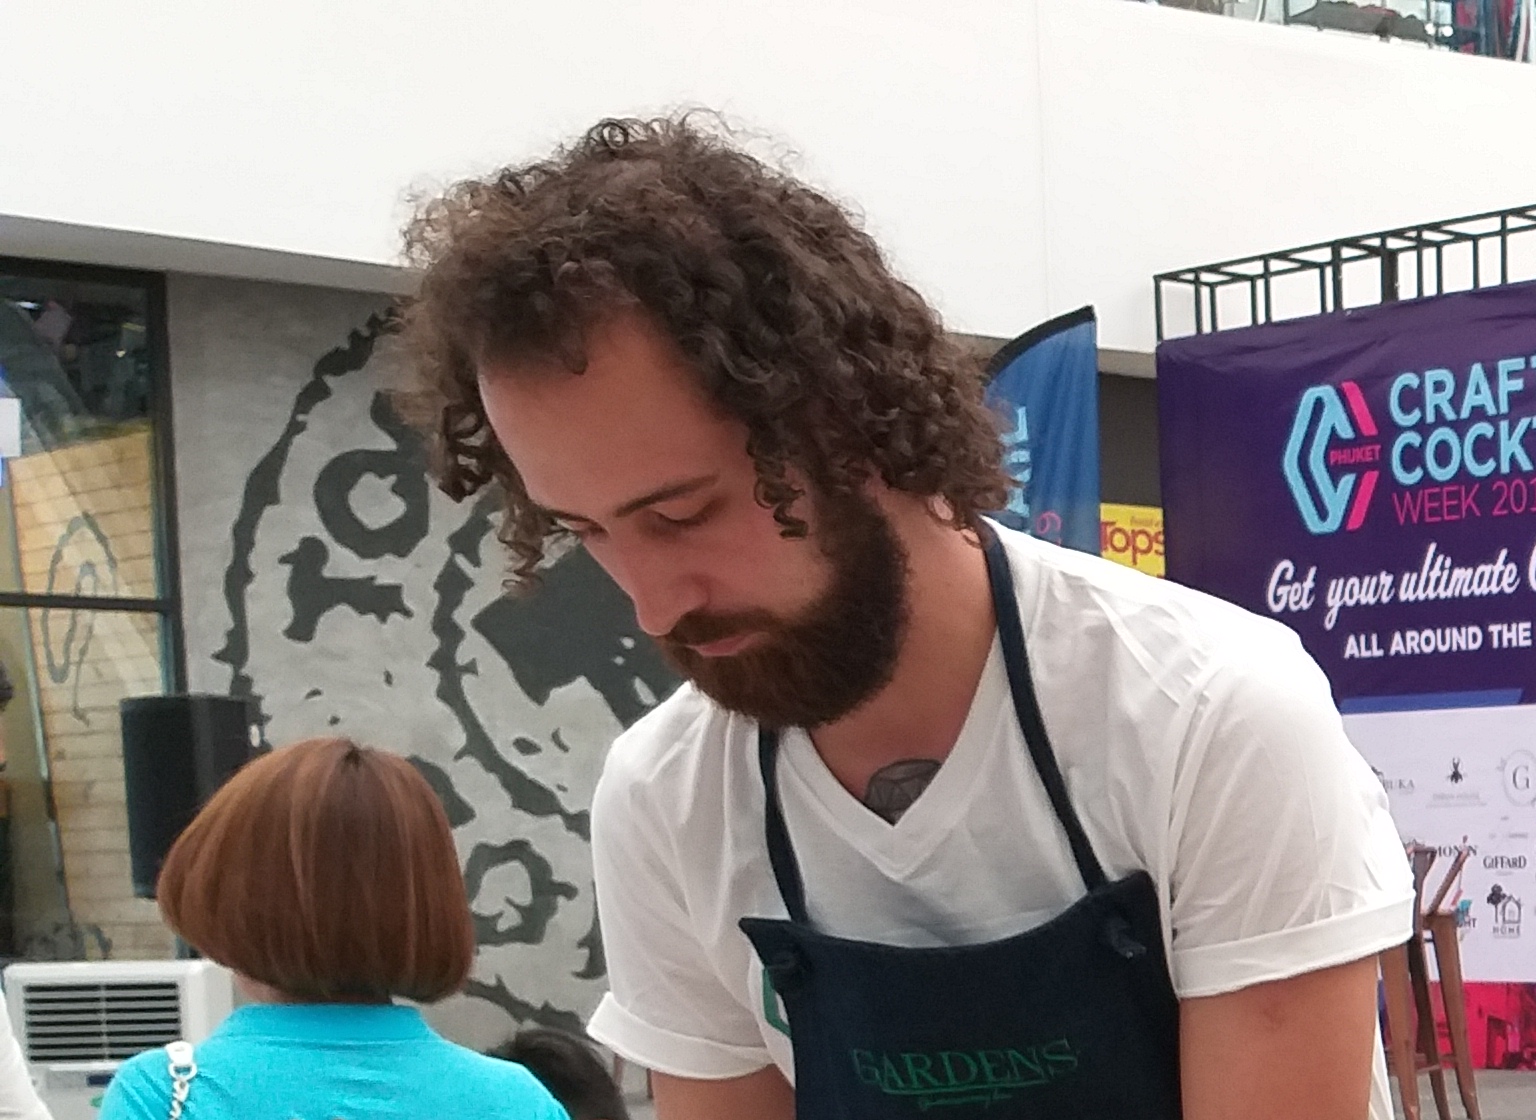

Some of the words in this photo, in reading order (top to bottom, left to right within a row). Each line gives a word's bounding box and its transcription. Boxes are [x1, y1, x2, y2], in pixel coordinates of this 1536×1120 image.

[1329, 444, 1382, 467] PHUKET
[1392, 484, 1481, 526] WEEK
[1266, 558, 1318, 613] Get
[1325, 572, 1397, 630] your
[1400, 541, 1521, 602] ultimate
[1343, 633, 1384, 659] ALL
[1389, 626, 1483, 656] AROUND
[1489, 622, 1532, 649] THE
[1483, 855, 1527, 870] GIFFARD
[1493, 926, 1521, 936] HOME
[852, 1036, 1080, 1089] GARDENS
